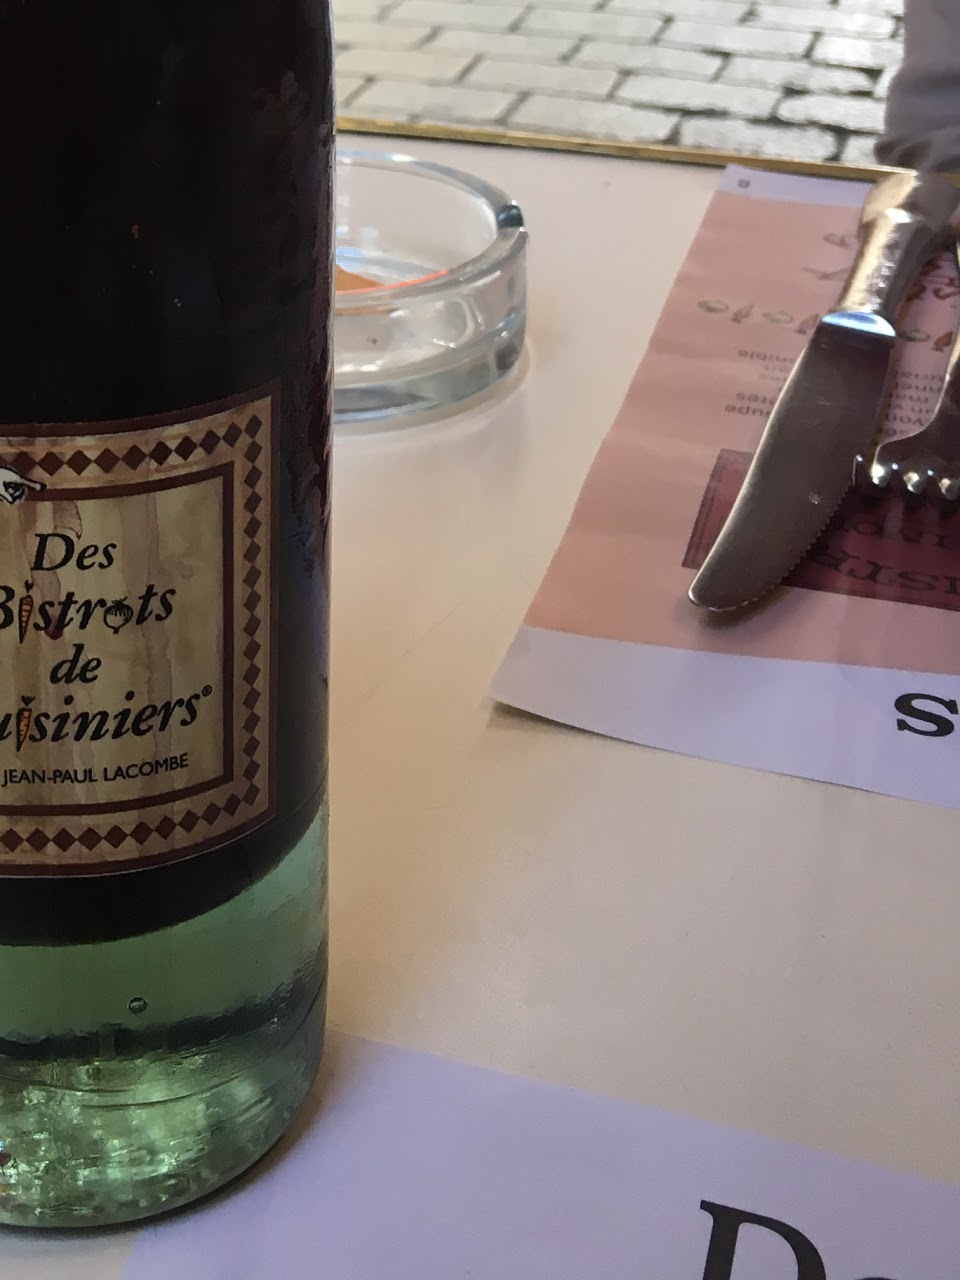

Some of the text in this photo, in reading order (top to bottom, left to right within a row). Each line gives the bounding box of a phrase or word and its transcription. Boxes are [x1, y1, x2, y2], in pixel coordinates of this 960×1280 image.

[32, 532, 117, 571] Des
[49, 643, 102, 684] de
[2, 768, 97, 787] JEAN-PAUL
[104, 752, 190, 783] LACOMBE
